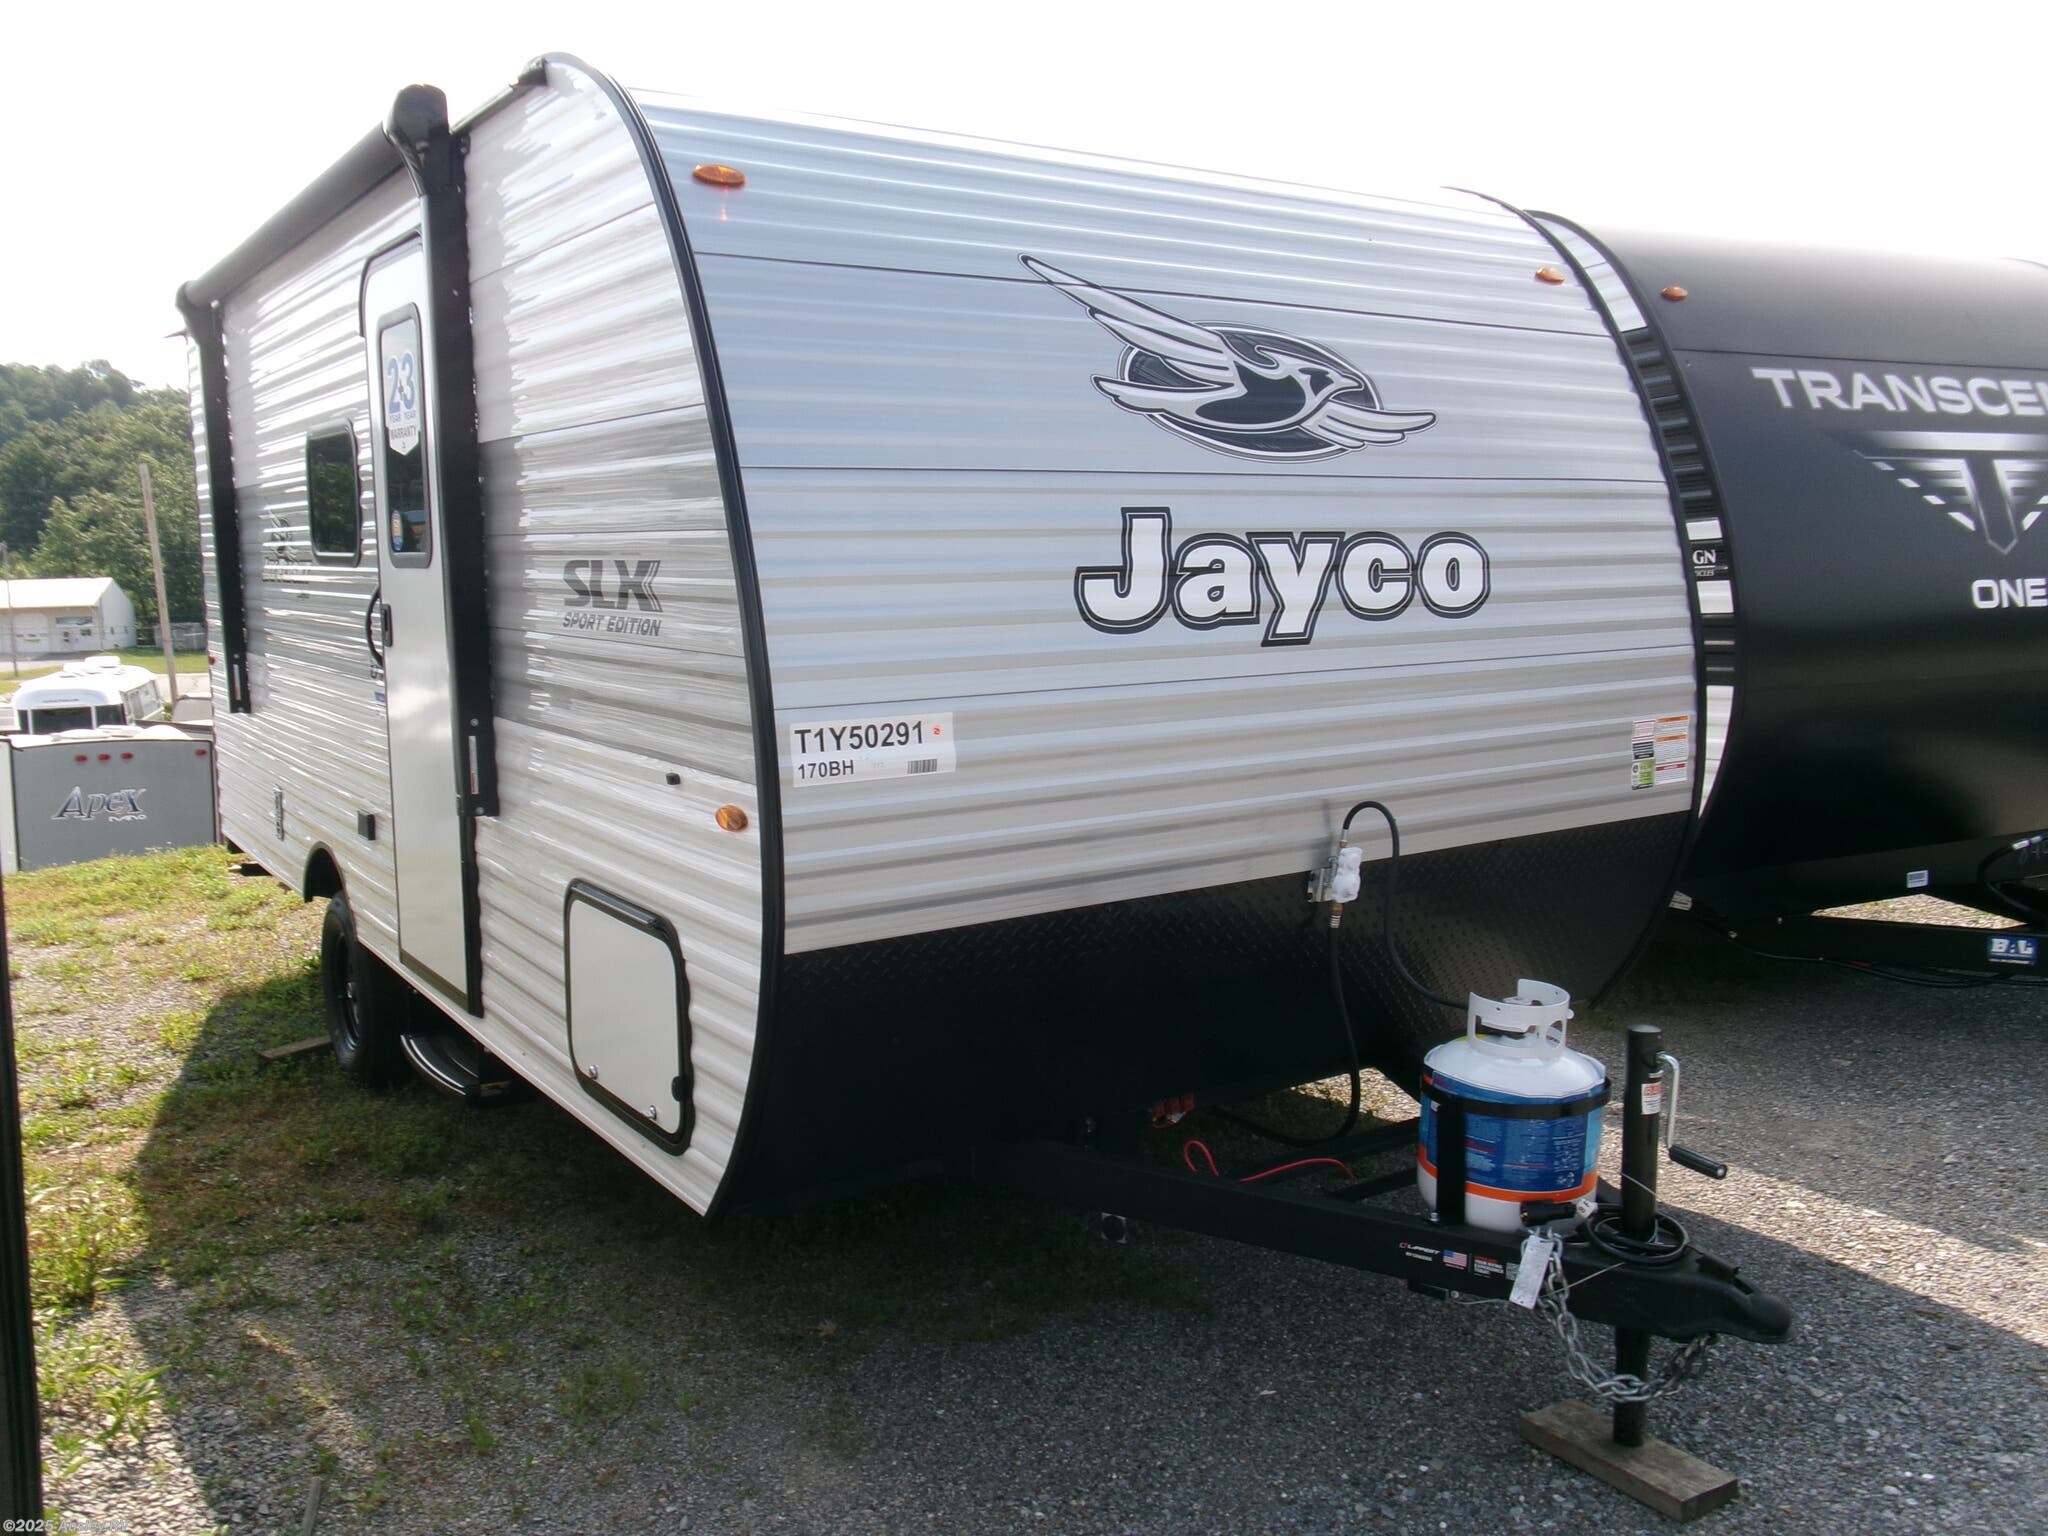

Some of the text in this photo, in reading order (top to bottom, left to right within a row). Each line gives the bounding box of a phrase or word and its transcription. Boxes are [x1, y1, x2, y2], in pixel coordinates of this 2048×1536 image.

[1751, 366, 2048, 416] TRANSCE
[562, 560, 663, 613] SLX
[1074, 507, 1490, 647] Jayco
[1972, 578, 2048, 609] ONE
[562, 611, 662, 637] SPORT EDITION
[794, 720, 923, 754] T1Y50291
[798, 759, 854, 779] 170BH
